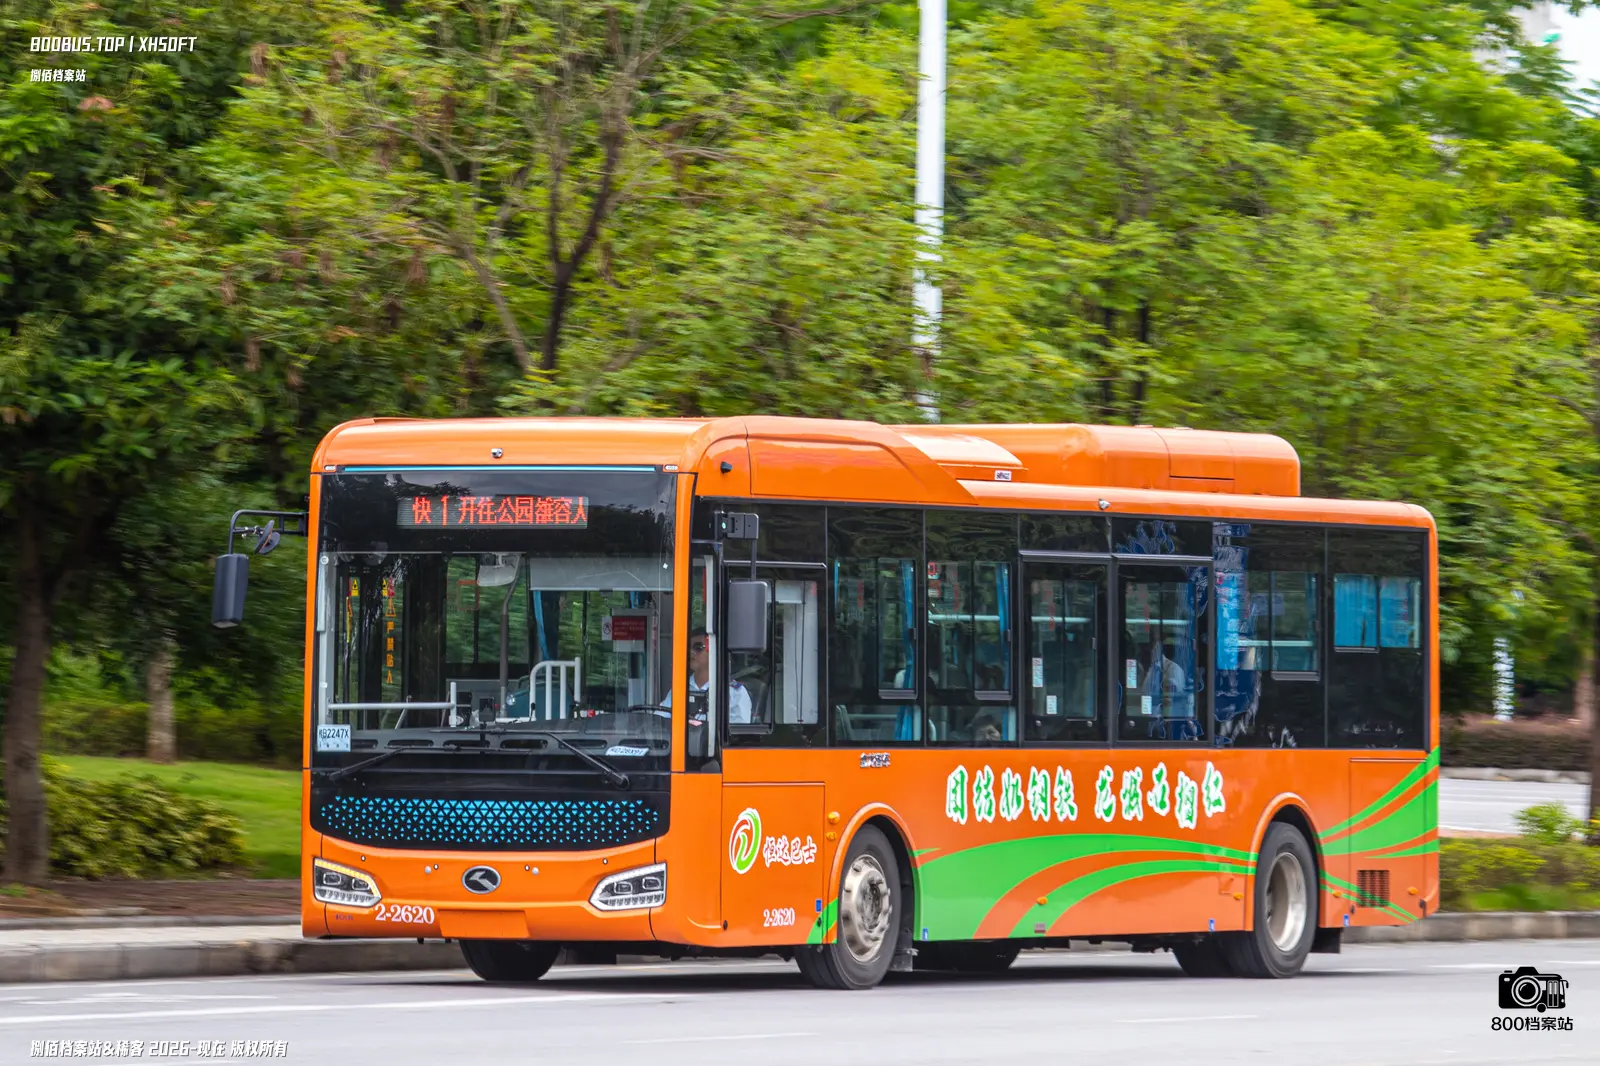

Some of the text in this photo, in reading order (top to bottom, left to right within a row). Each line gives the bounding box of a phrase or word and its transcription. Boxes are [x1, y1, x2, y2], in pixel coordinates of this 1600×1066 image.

[412, 496, 432, 524] 快
[763, 835, 817, 867] 恒达巴士
[374, 903, 435, 925] 2-2620
[763, 907, 796, 927] 2-2620
